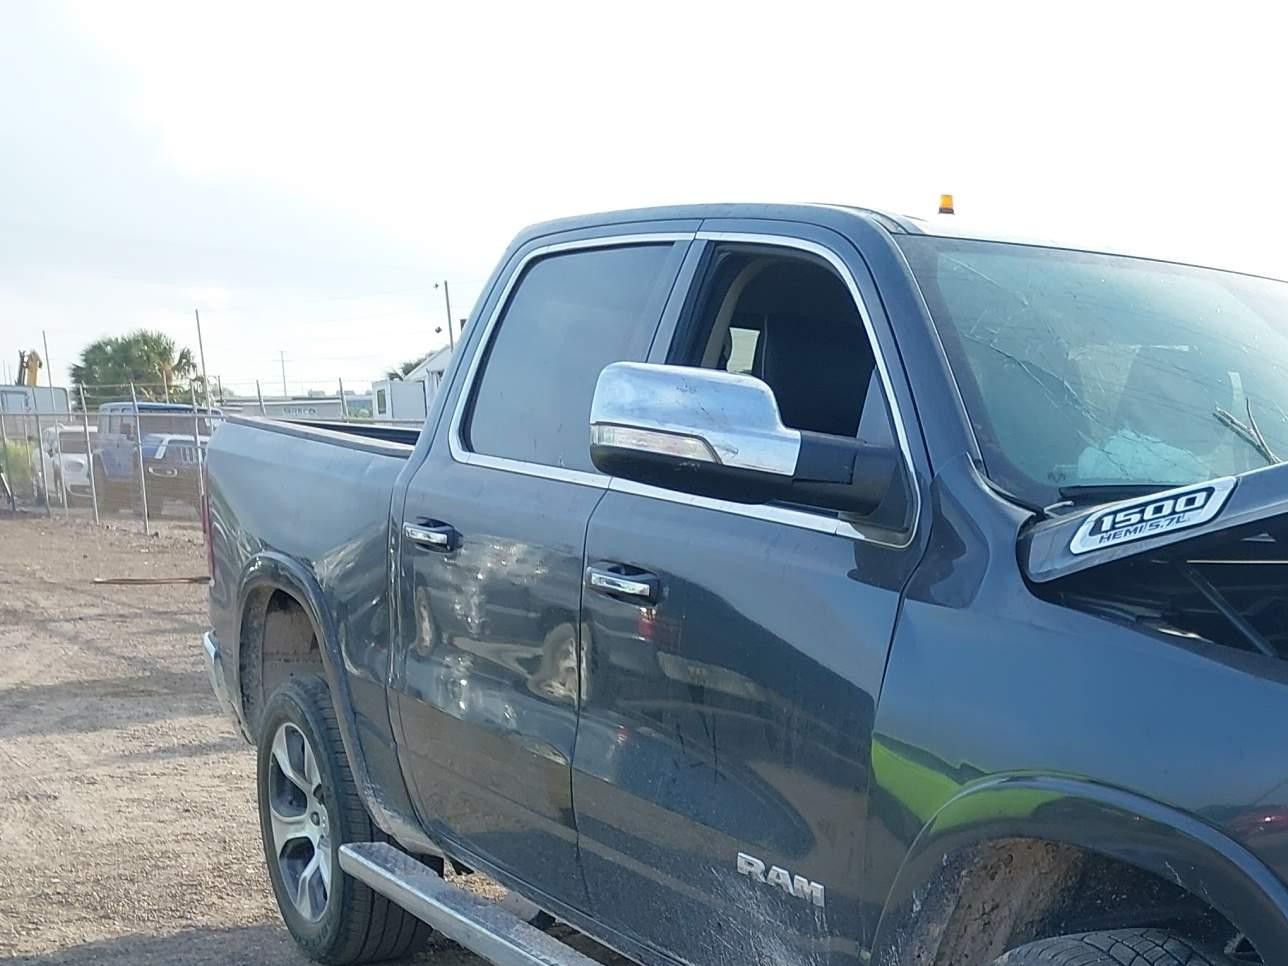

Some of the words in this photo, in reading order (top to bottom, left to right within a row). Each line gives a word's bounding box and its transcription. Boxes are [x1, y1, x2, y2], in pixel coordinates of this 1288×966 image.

[1098, 524, 1145, 544] HEMI
[1147, 513, 1186, 531] 5.7L
[1101, 491, 1207, 532] 1500
[737, 851, 825, 908] RAM
